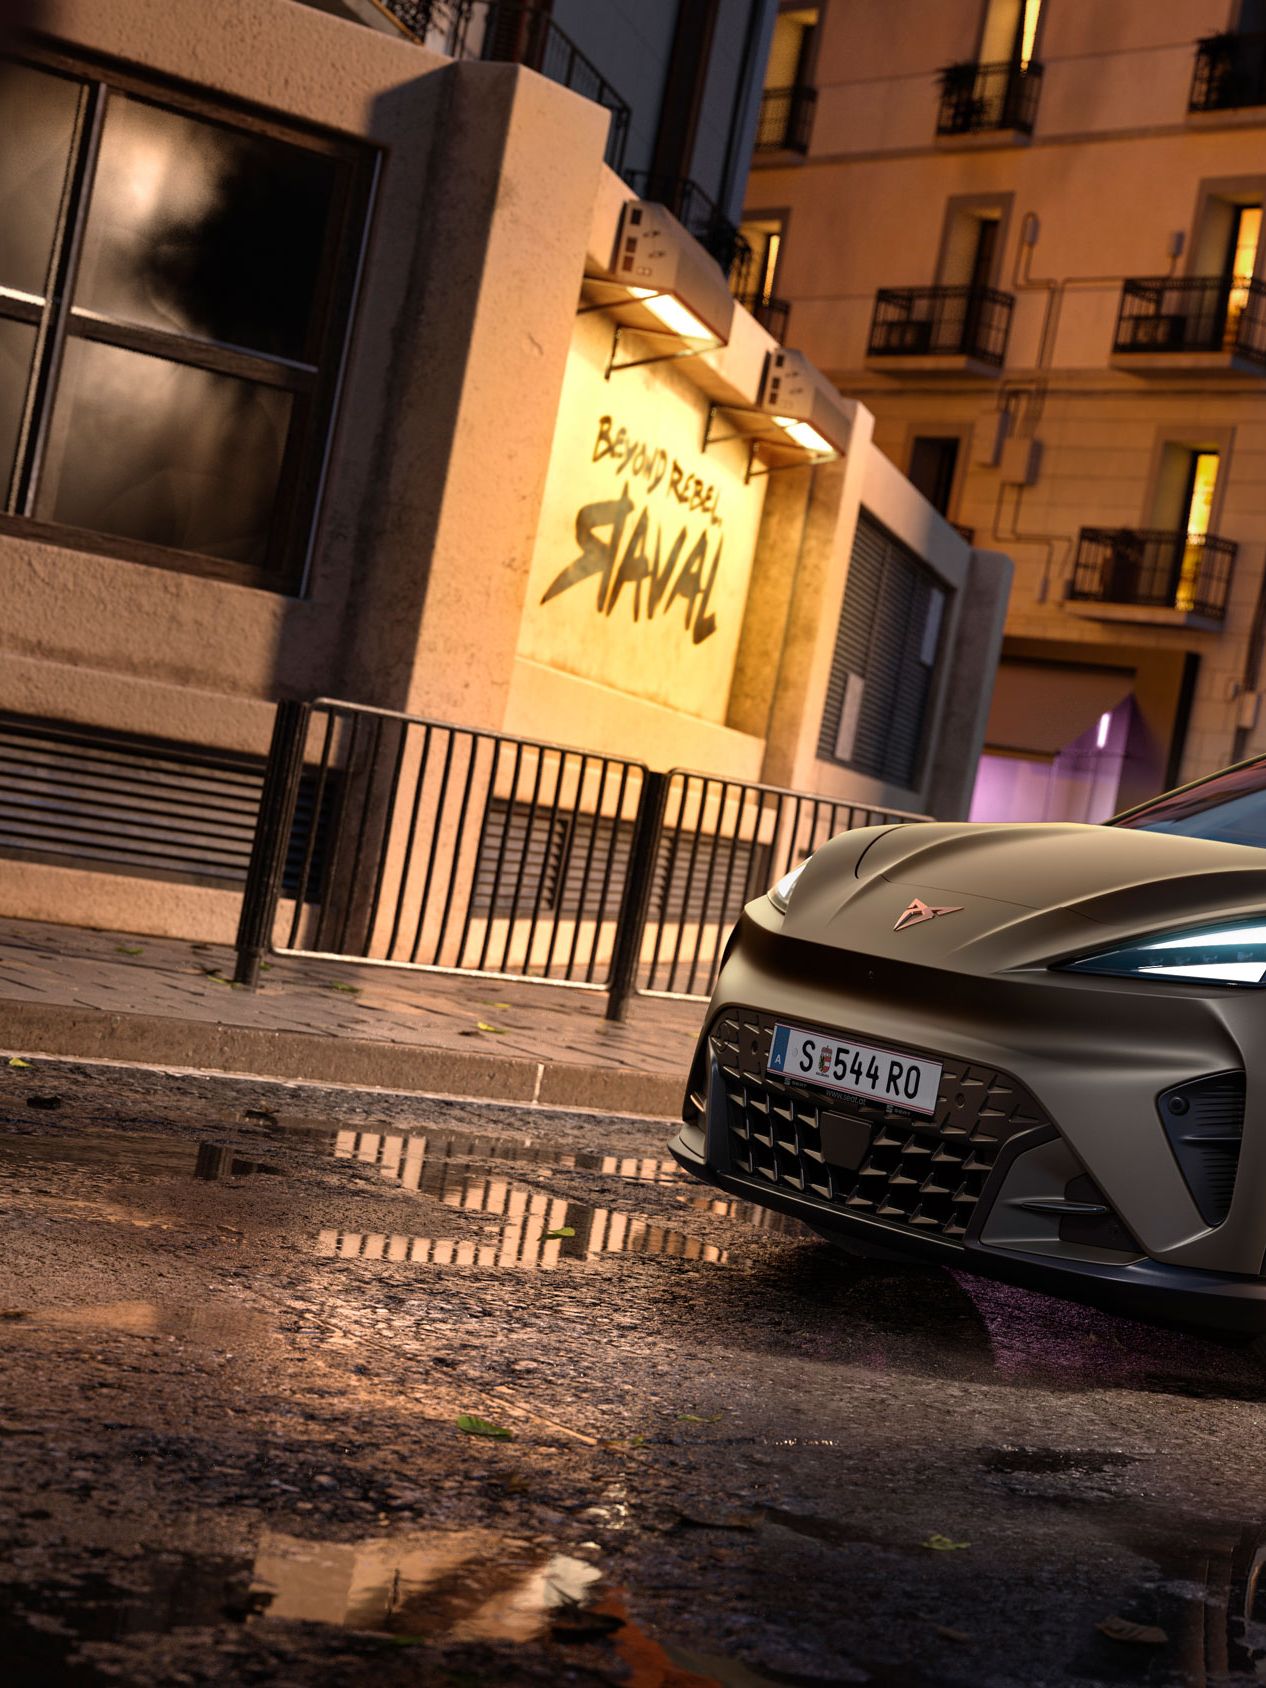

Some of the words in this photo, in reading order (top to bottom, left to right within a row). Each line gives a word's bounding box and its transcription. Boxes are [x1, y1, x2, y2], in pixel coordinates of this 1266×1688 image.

[540, 480, 723, 645] RAVAL
[774, 1054, 781, 1064] A
[799, 1040, 816, 1072] S
[833, 1047, 880, 1090] 544
[885, 1060, 921, 1100] RO
